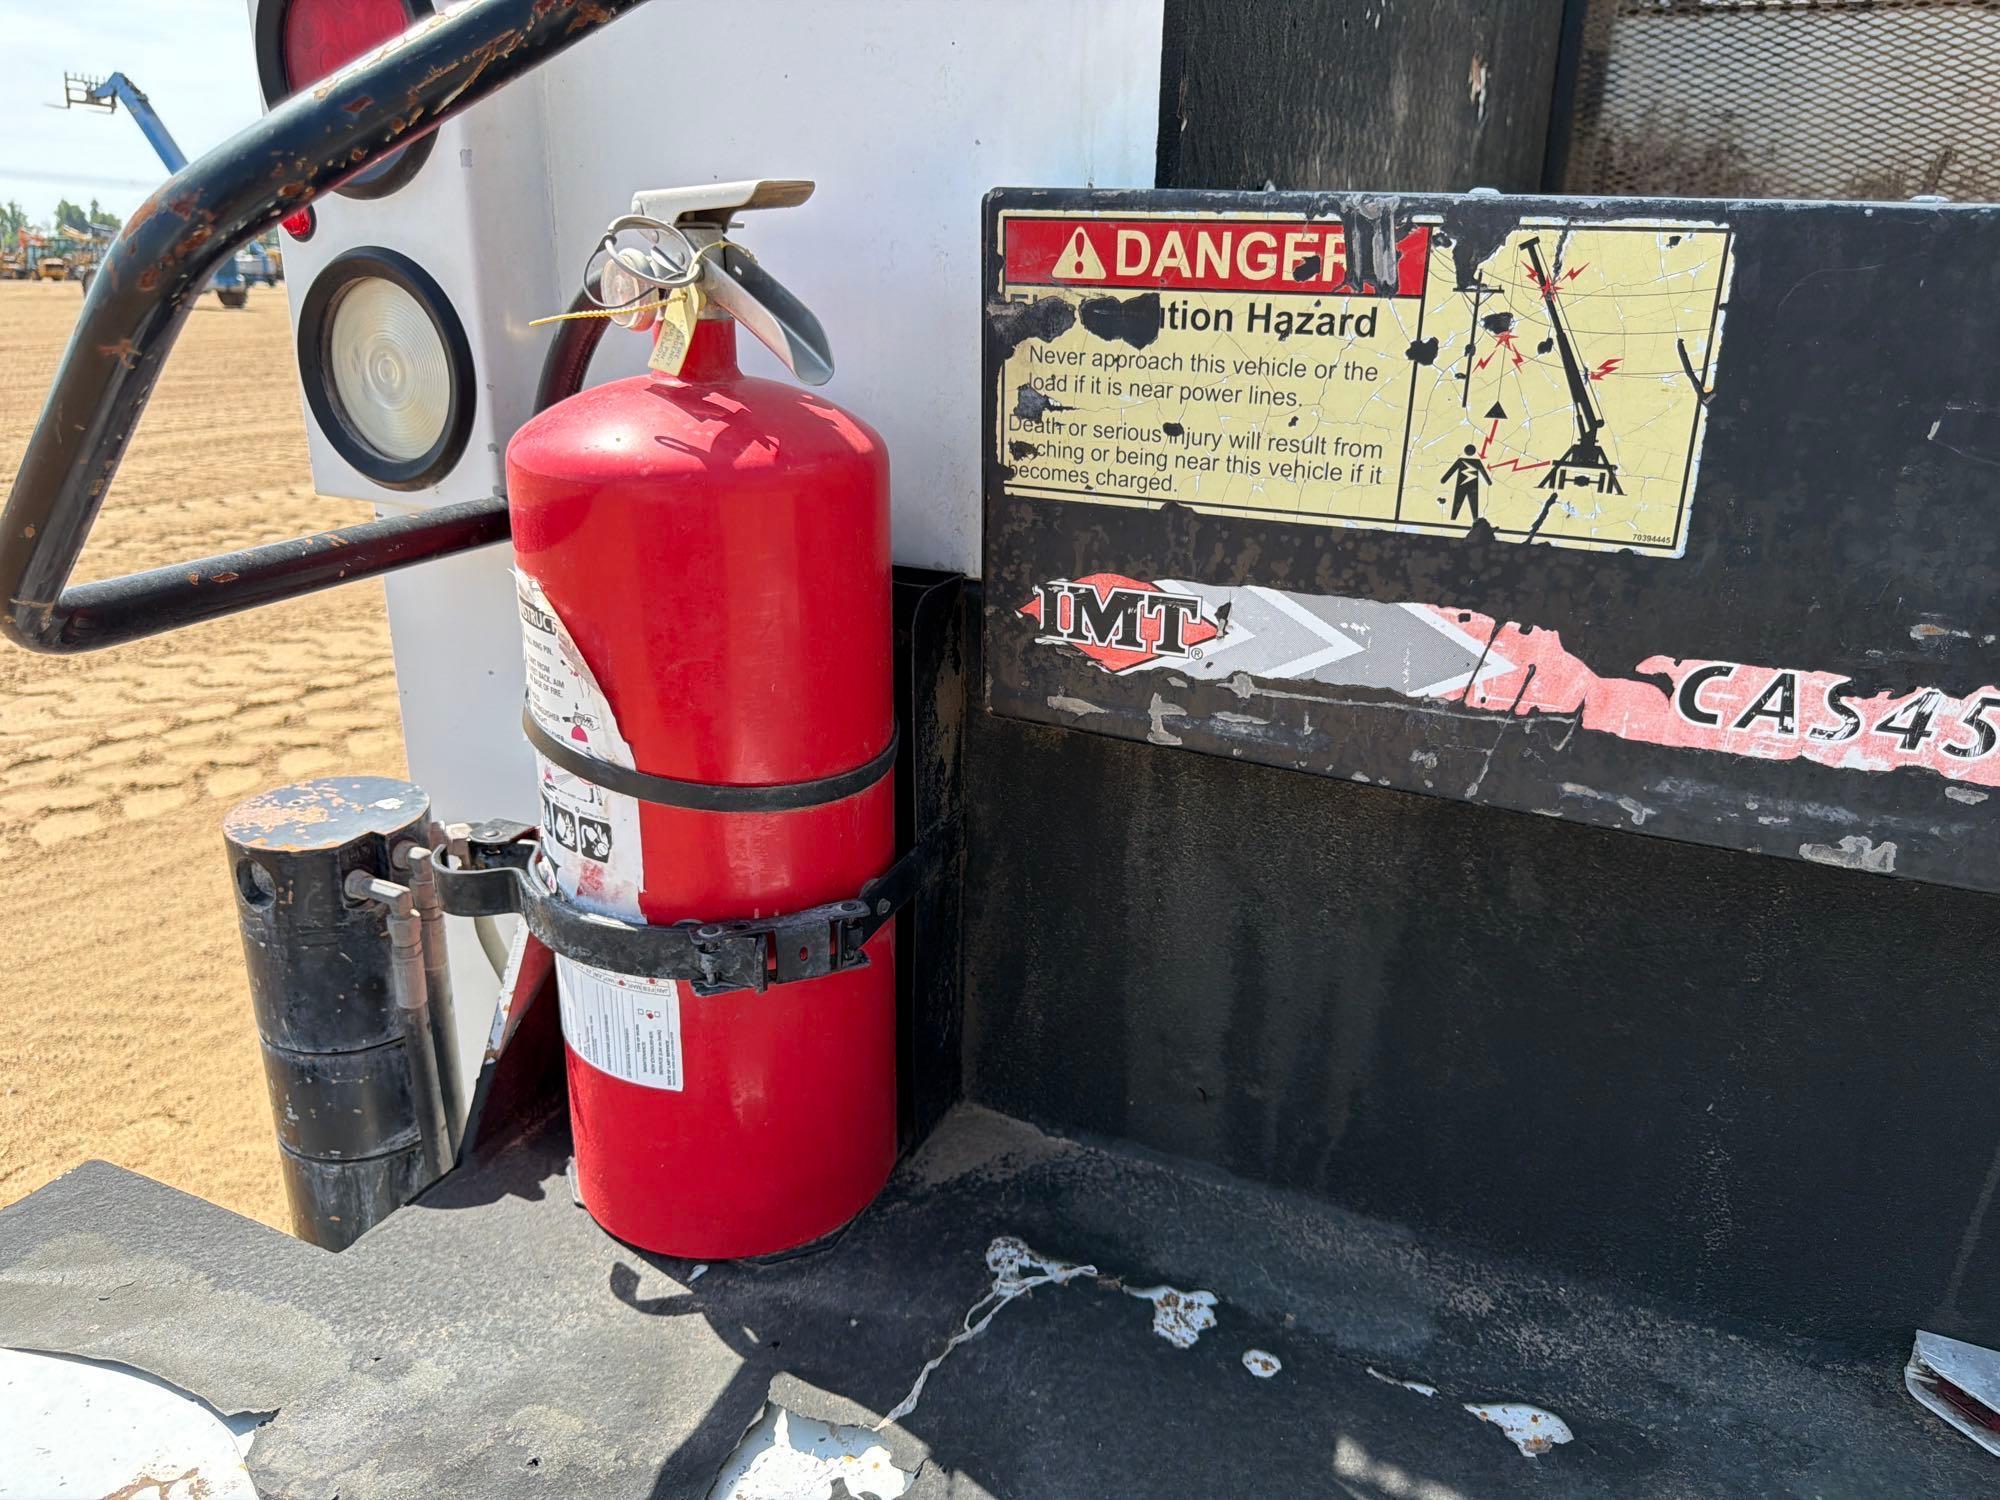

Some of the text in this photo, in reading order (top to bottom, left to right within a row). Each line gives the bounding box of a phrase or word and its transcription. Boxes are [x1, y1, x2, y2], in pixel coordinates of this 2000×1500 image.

[1248, 303, 1377, 338] Hazard
[1030, 345, 1378, 382] Never approach this vehicle or the
[1029, 372, 1302, 407] load if it is near power lines.
[1009, 414, 1062, 435] Death
[1068, 422, 1087, 437] or
[1093, 422, 1162, 443] serious
[1229, 430, 1261, 451] will
[1268, 435, 1327, 455] result
[1334, 437, 1383, 459] from
[1091, 448, 1110, 462] or
[1116, 446, 1168, 471] being
[1175, 455, 1220, 472] near
[1226, 455, 1261, 475] this
[1268, 460, 1343, 482] vehicle
[1350, 463, 1364, 483] if
[1370, 465, 1382, 485] it
[1095, 469, 1178, 494] charged.
[1632, 534, 1671, 544] 70394445
